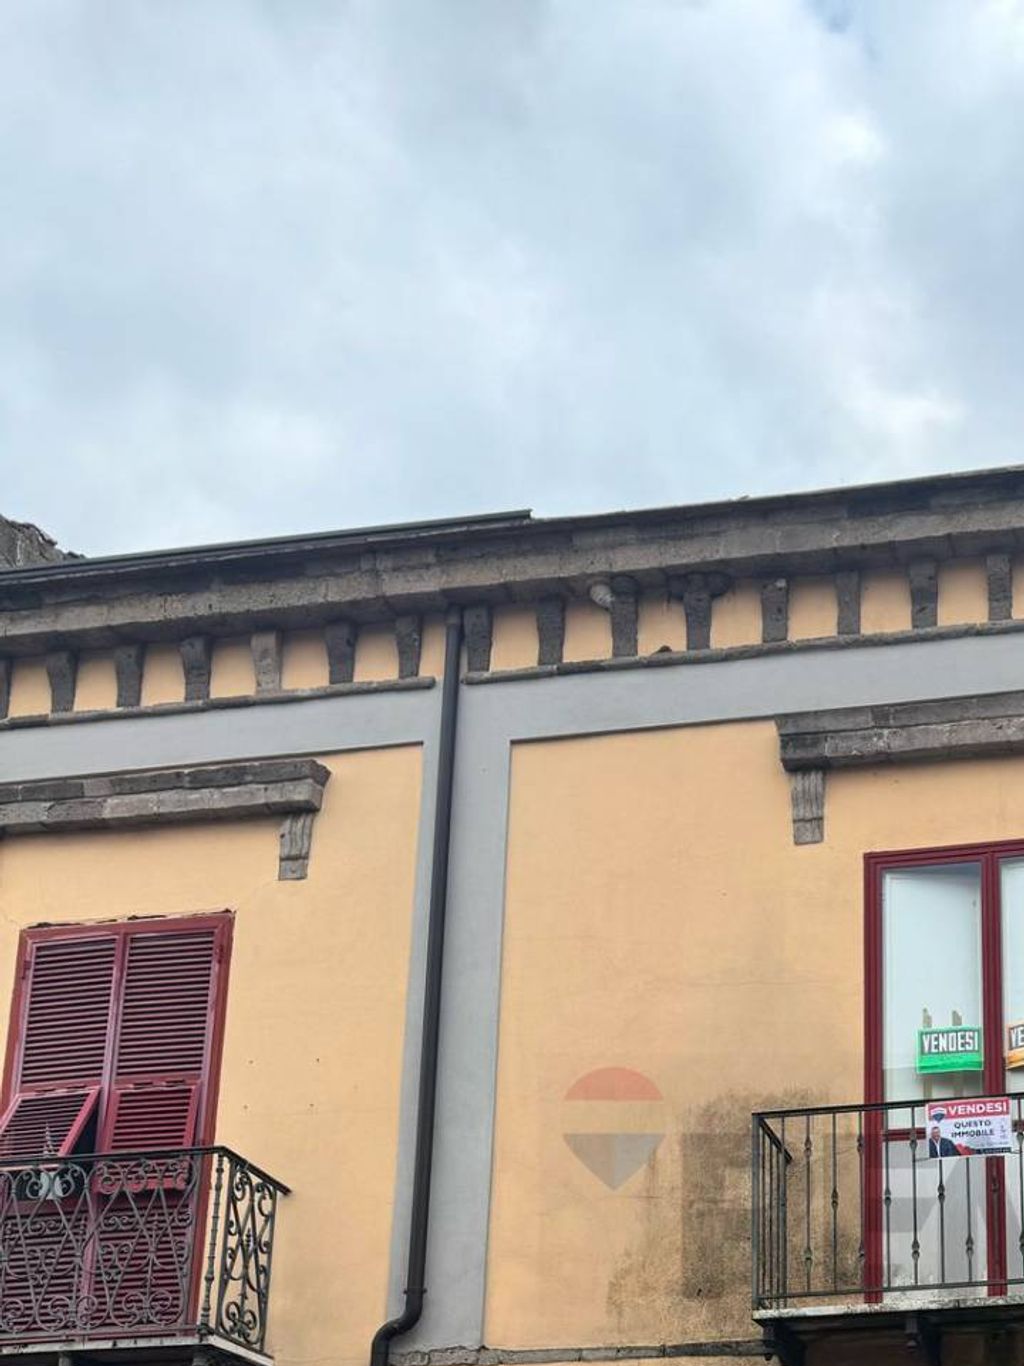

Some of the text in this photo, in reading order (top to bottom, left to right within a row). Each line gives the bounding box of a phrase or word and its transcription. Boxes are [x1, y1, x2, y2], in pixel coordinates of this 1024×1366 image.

[922, 1031, 979, 1053] VENDESI
[947, 1102, 1007, 1116] VENDESI
[953, 1119, 992, 1129] QUESTO
[951, 1128, 995, 1138] IMMOBILE
